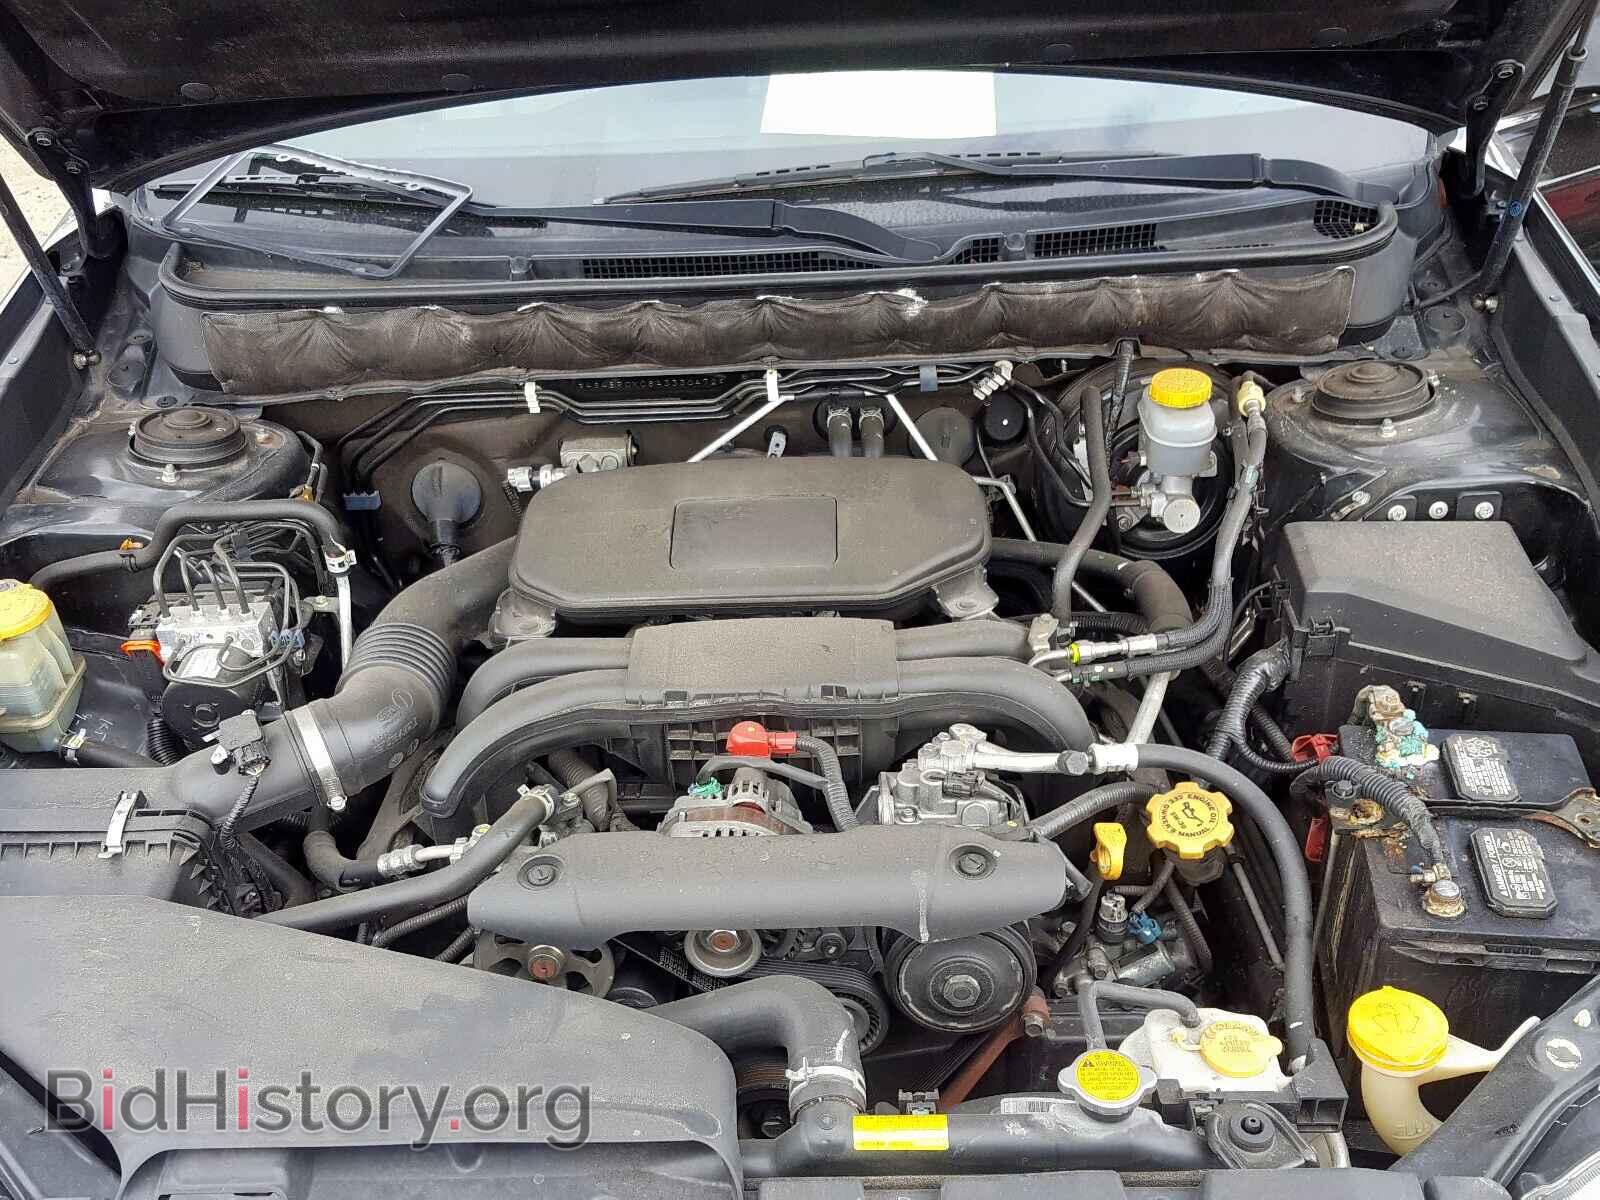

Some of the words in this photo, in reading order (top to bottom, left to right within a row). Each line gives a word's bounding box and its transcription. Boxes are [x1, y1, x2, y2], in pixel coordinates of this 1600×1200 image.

[1168, 794, 1184, 804] SEE
[1178, 827, 1211, 837] MANUAL
[1187, 793, 1215, 811] ENGINE
[1209, 812, 1217, 824] OIL
[1483, 835, 1496, 858] POISON
[1491, 864, 1507, 890] DANGER
